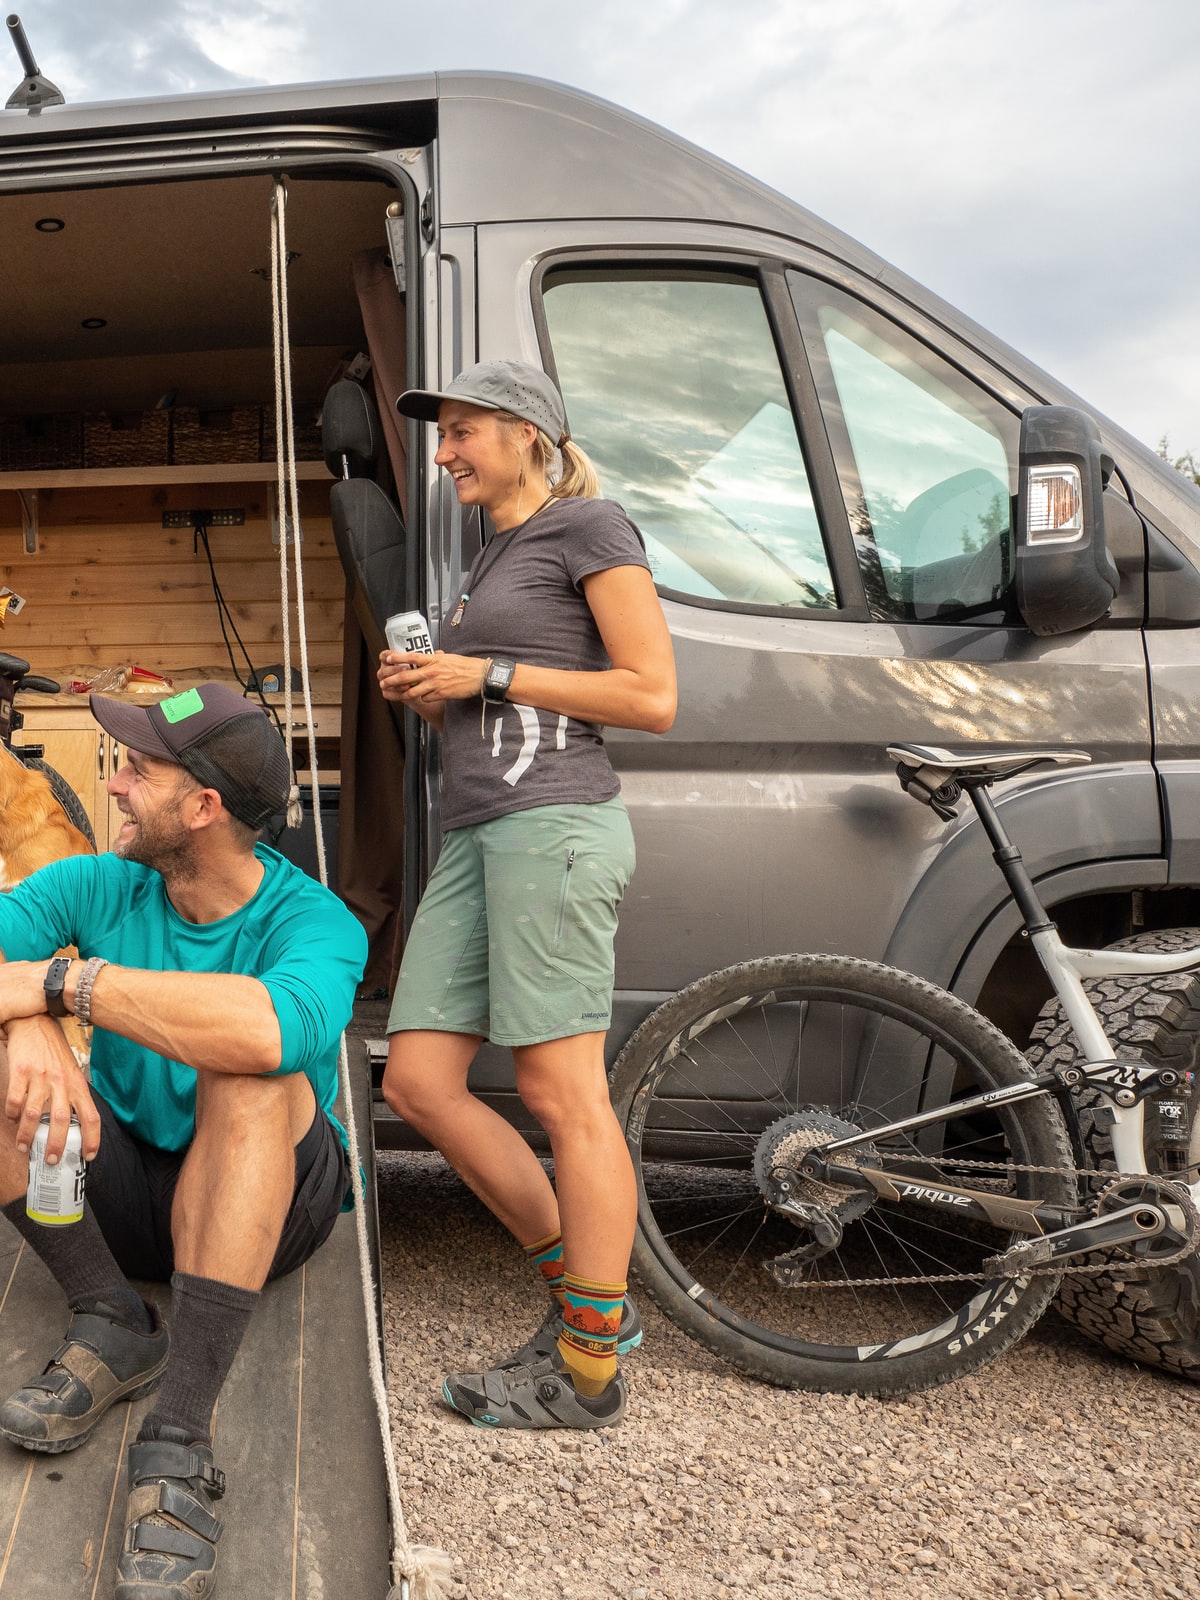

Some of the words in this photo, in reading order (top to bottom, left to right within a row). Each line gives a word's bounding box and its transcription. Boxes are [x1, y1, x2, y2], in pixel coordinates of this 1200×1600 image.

[405, 634, 430, 652] JOE
[1159, 1105, 1182, 1117] FOX
[947, 1272, 1032, 1355] MAXXIS
